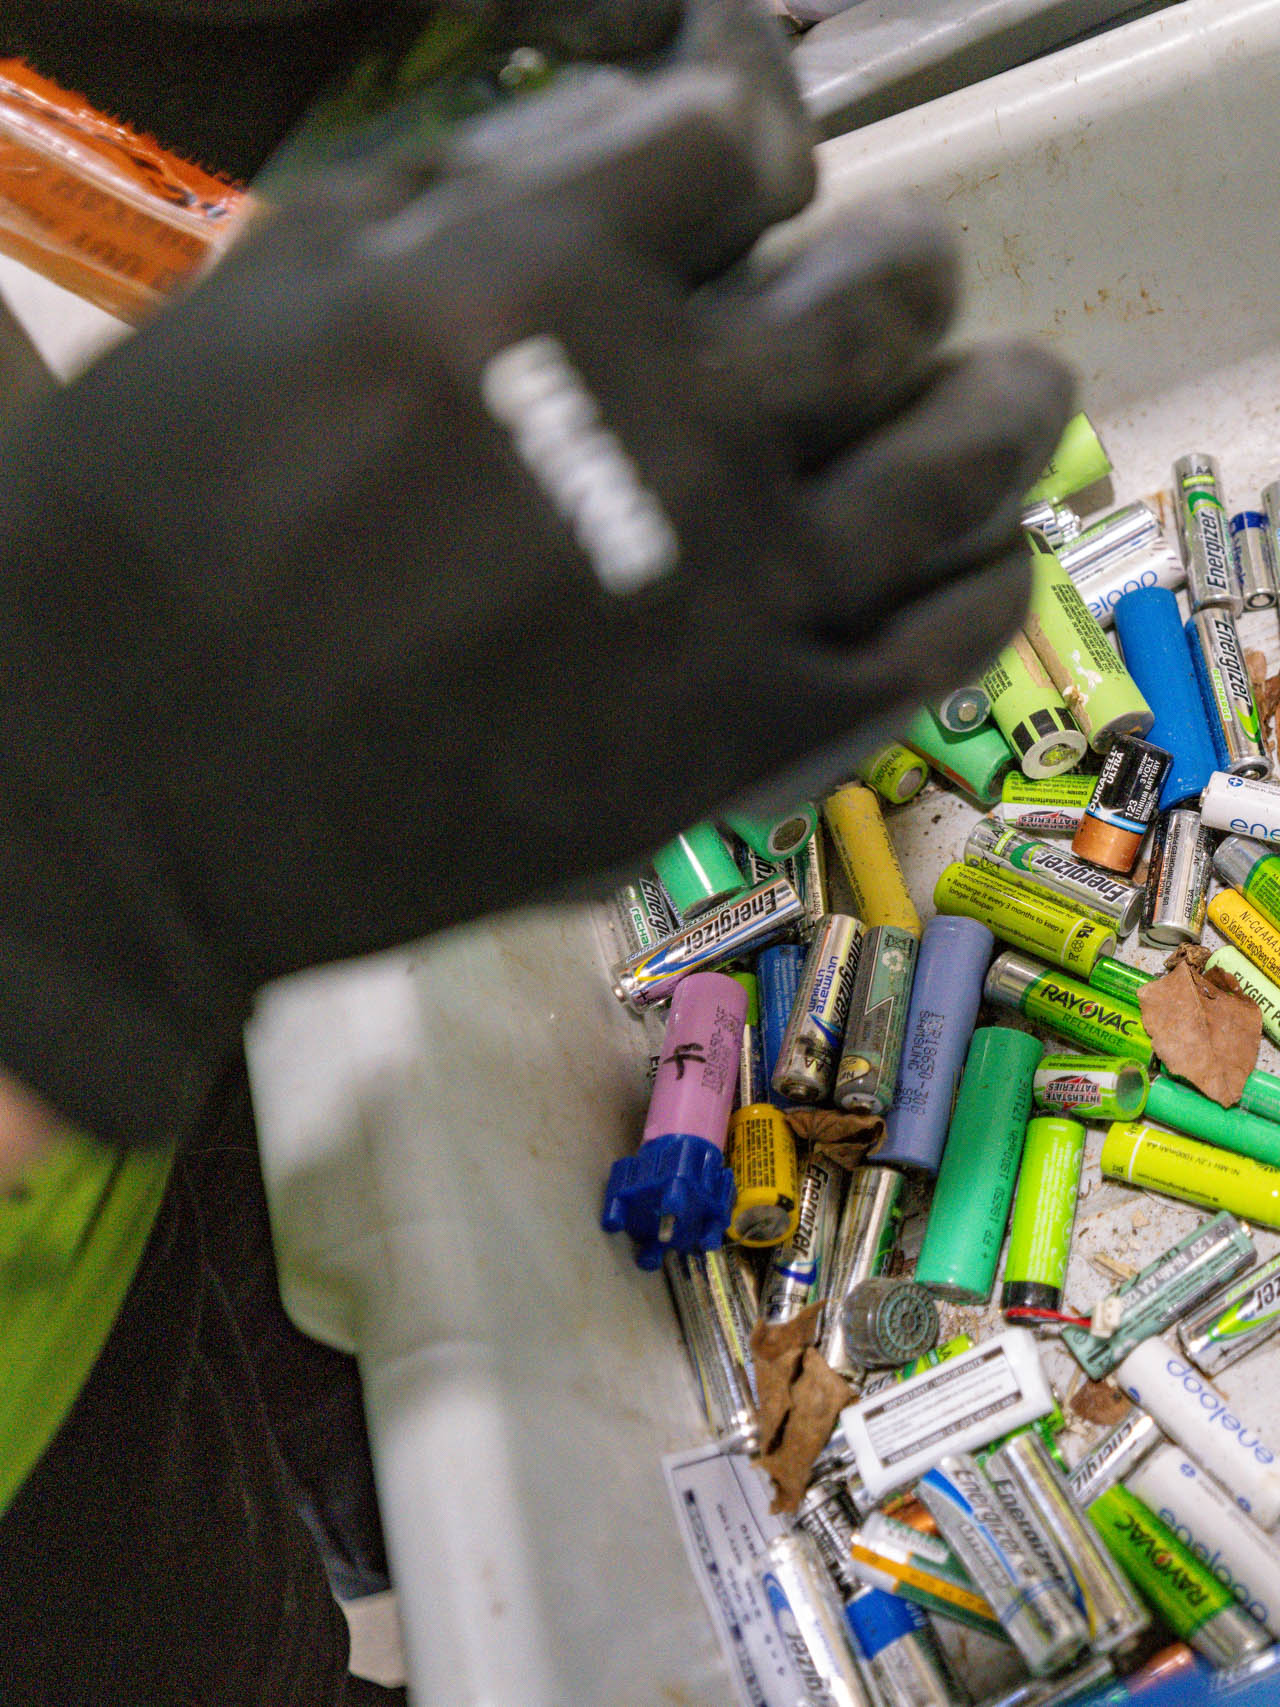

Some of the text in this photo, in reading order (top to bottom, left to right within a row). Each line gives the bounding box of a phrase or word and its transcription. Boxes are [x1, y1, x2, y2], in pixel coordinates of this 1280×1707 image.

[1201, 509, 1228, 591] Energizer
[1213, 619, 1251, 706] Energizer
[1085, 747, 1120, 812] DURACELL
[1104, 750, 1125, 784] ULTRA
[1131, 789, 1150, 820] LITHIUM
[1143, 760, 1162, 790] BATTERY
[1138, 776, 1147, 784] 3
[1140, 756, 1155, 778] VOLT
[1123, 798, 1138, 818] 123
[1035, 850, 1130, 903] Energizer
[1162, 895, 1169, 906] US
[1166, 844, 1178, 879] IMPORTED
[1172, 823, 1181, 844] PARTS
[1183, 888, 1195, 918] CR123A
[1193, 855, 1200, 865] 3V
[684, 887, 777, 957] Energizer
[947, 886, 994, 913] longer lifespan
[951, 877, 982, 898] Recharge
[1010, 904, 1035, 921] months
[1043, 920, 1060, 932] keep
[1238, 909, 1263, 934] Ni-Cd
[1040, 984, 1138, 1037] RAYOVAC
[1062, 1013, 1126, 1048] RECHARGE
[907, 1011, 931, 1071] SAMSUNG
[1044, 1093, 1098, 1102] INTERSTATE
[1048, 1083, 1096, 1092] BATTERIES
[1137, 1275, 1158, 1295] AA
[1166, 1359, 1274, 1465] eneloop
[1114, 1513, 1209, 1607] RAYOVAC
